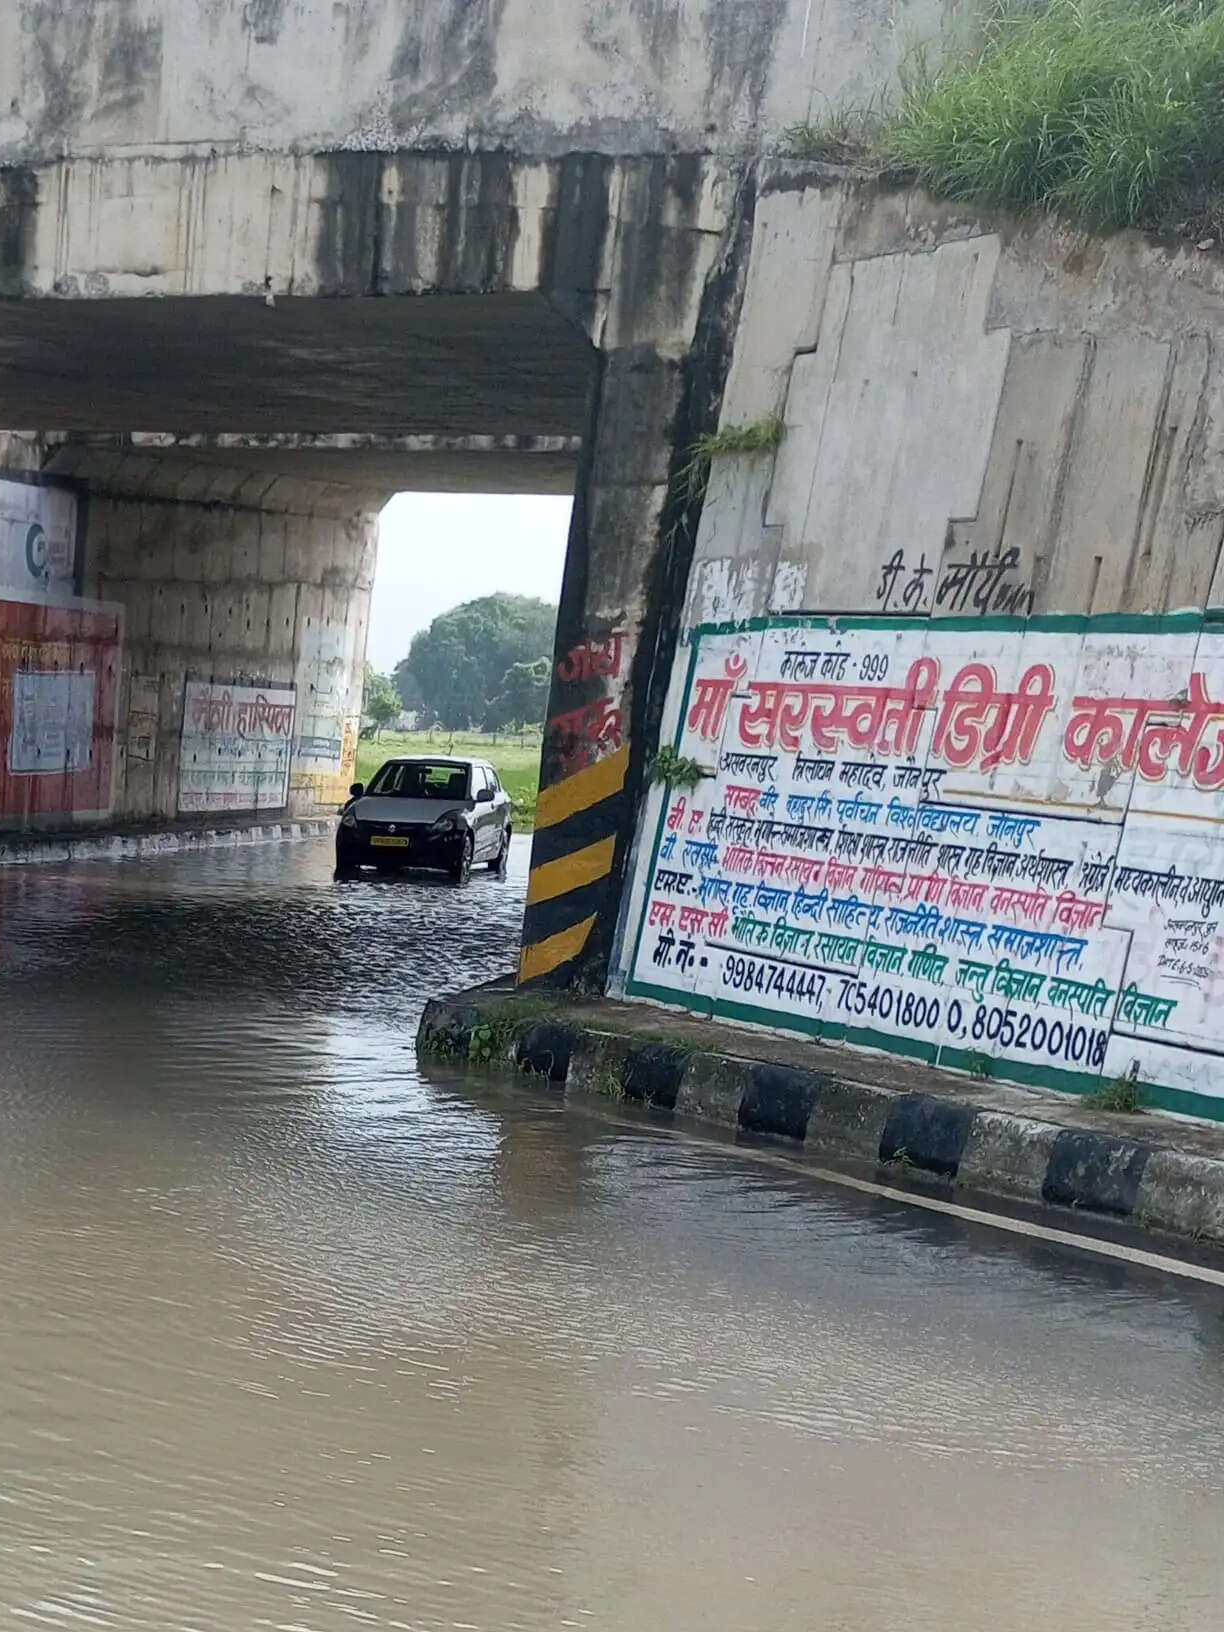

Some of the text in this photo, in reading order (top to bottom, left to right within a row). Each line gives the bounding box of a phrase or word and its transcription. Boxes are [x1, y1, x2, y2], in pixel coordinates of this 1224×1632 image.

[859, 653, 889, 682] 999
[687, 654, 749, 742] माँ
[738, 656, 944, 755] सरस्वती
[932, 662, 1058, 774] डिग्री
[972, 1003, 1107, 1067] 8052001018
